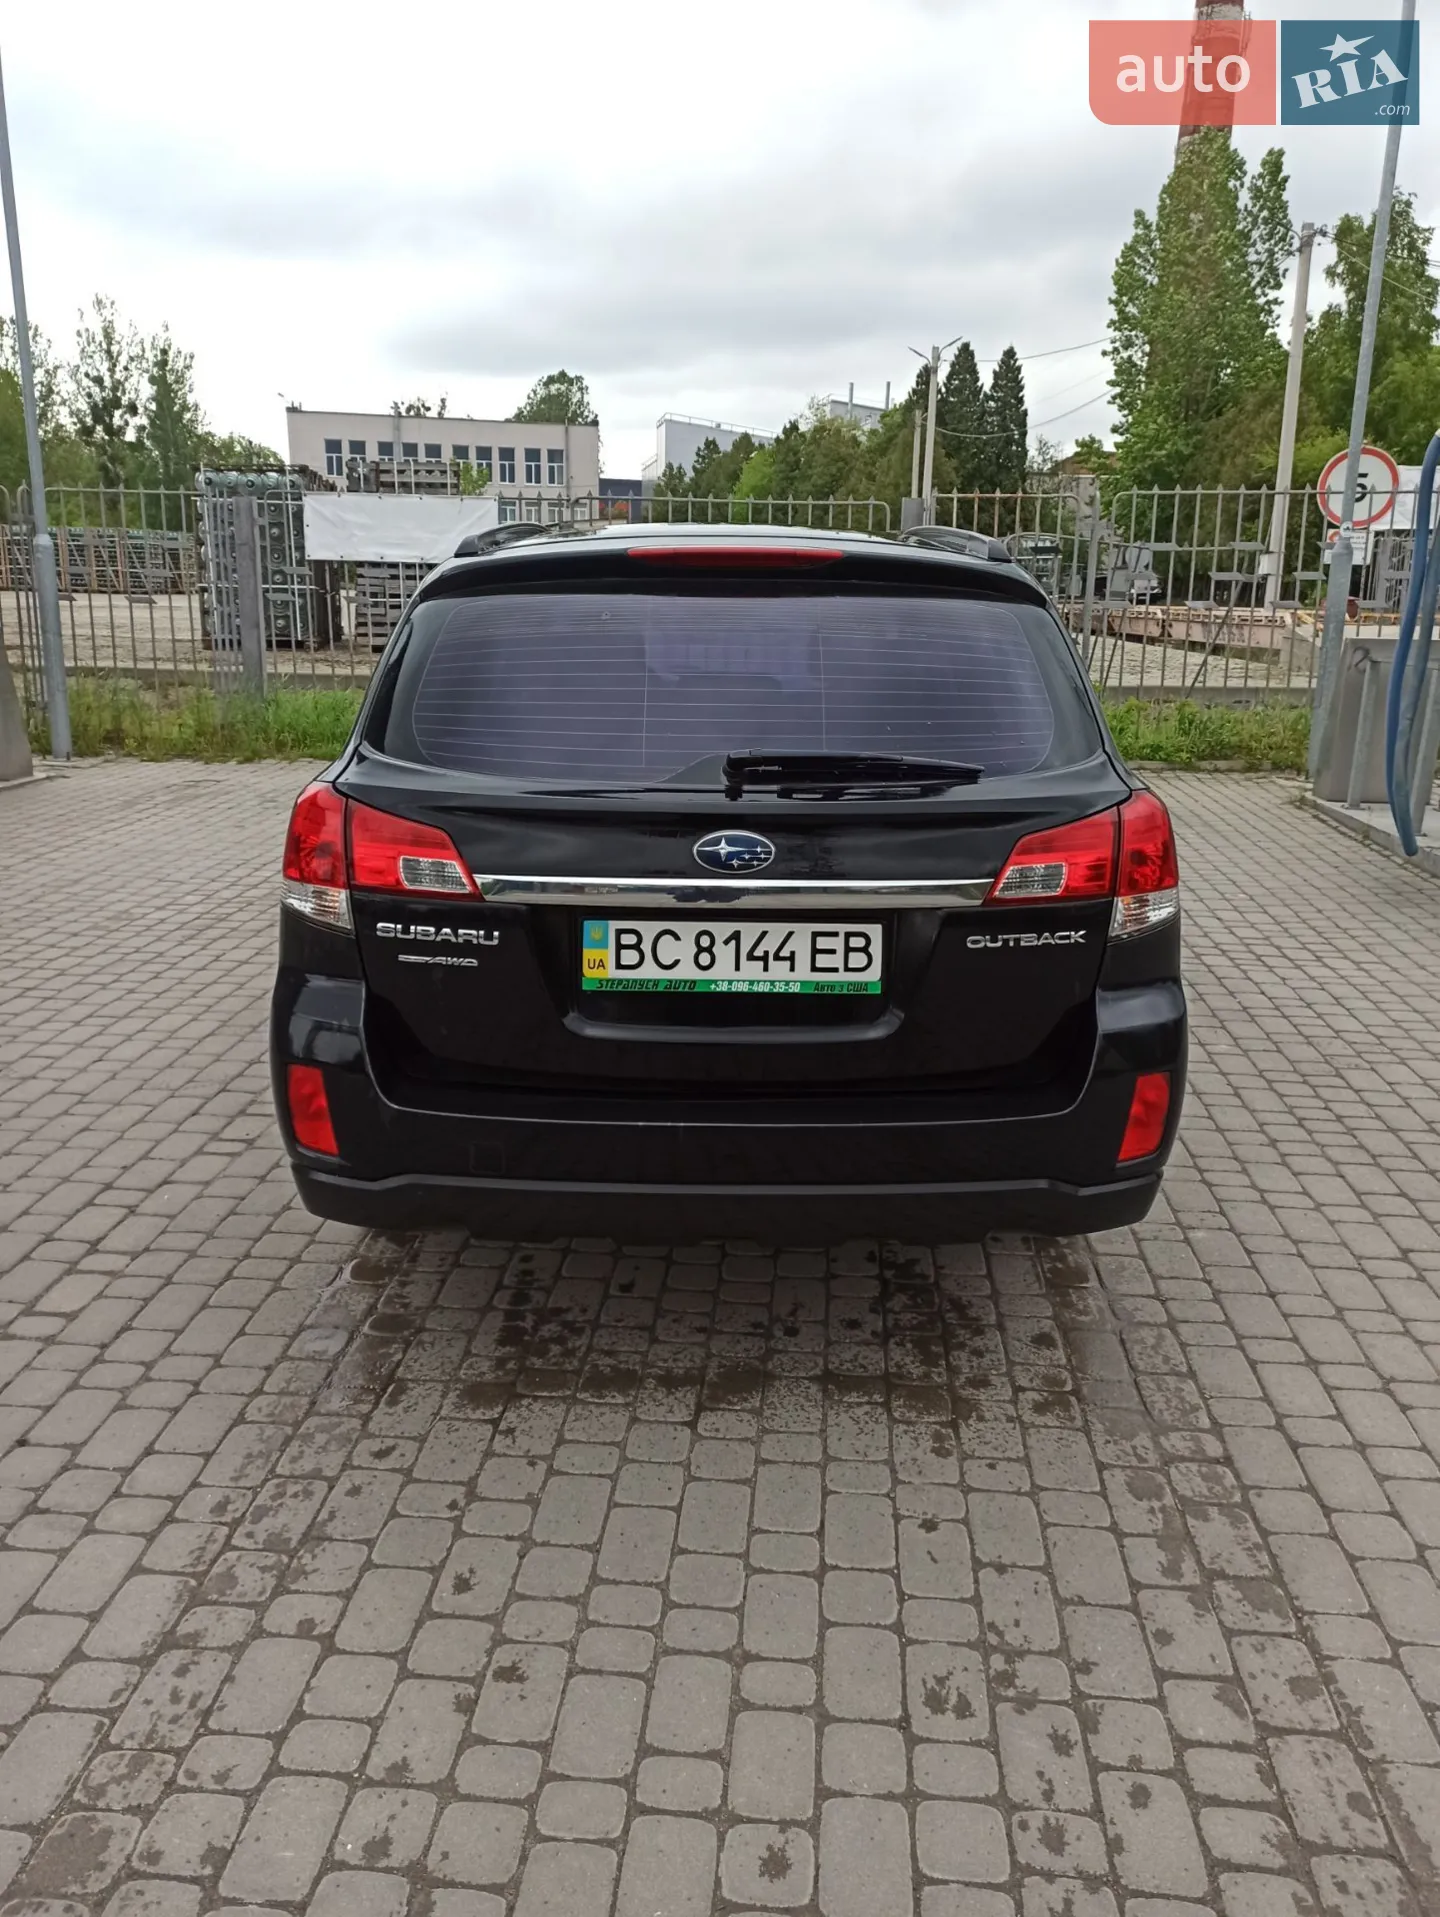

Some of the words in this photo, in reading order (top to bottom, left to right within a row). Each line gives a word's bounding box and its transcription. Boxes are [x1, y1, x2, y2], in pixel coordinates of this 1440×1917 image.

[376, 922, 499, 945] SUBARU
[966, 930, 1086, 948] OUTBACK
[614, 928, 682, 971] BC
[693, 929, 795, 972] 8144
[810, 931, 873, 973] EB
[587, 958, 606, 970] UA
[709, 980, 800, 992] +38-096-460-35-50
[846, 982, 869, 993] США
